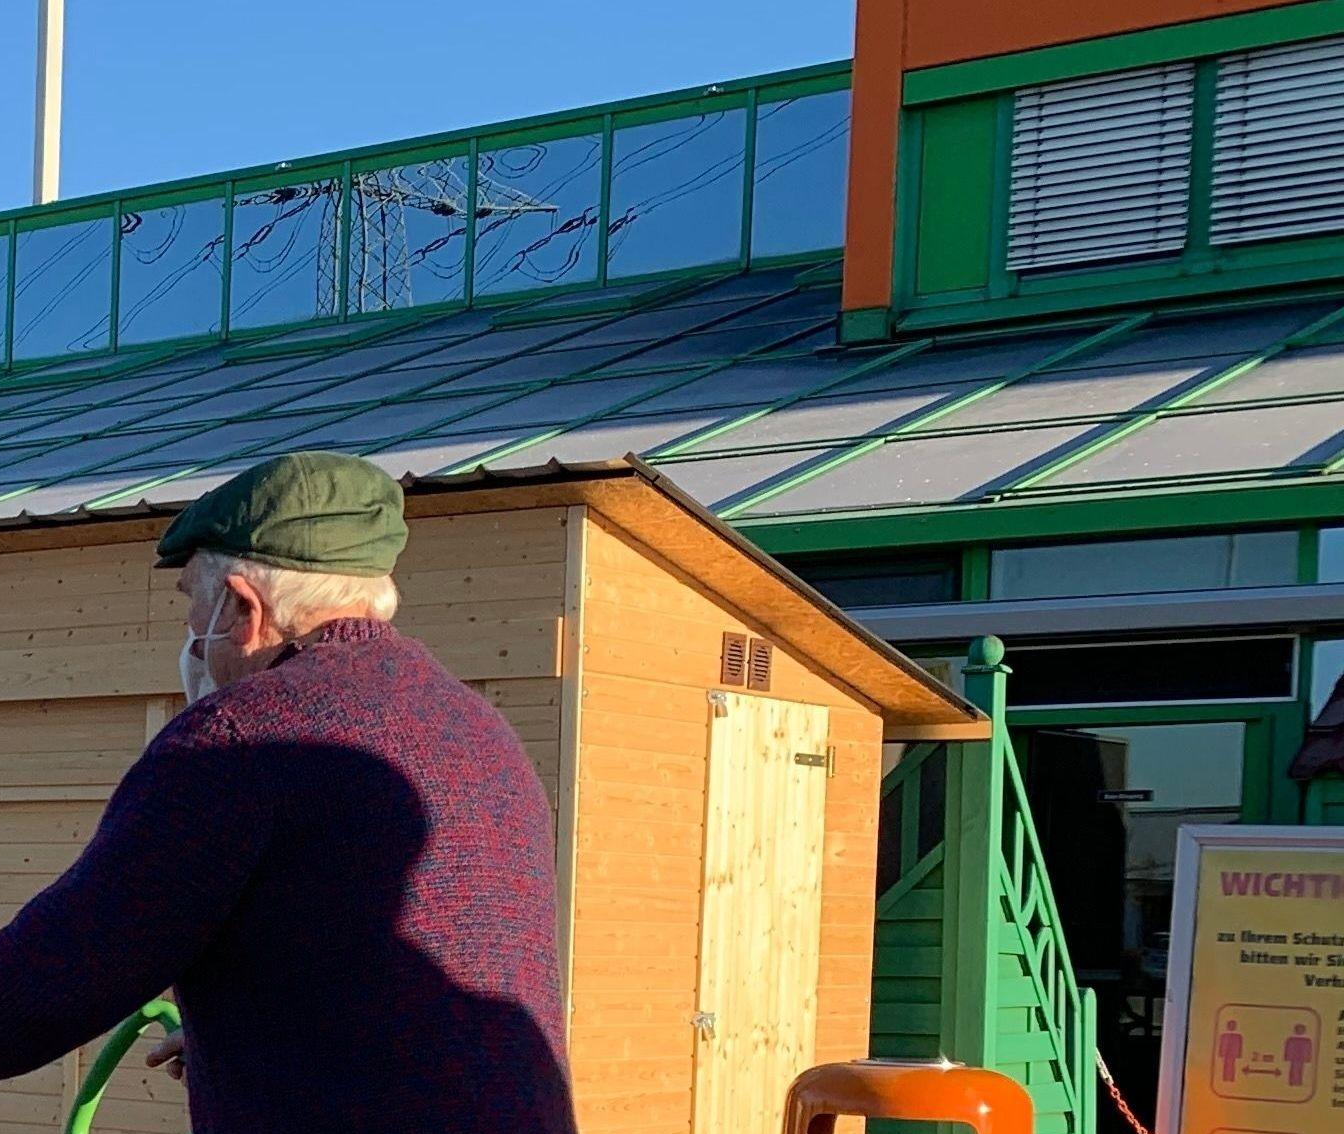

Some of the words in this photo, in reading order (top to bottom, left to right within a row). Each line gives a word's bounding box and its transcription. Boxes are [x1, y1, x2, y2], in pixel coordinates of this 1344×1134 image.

[1221, 871, 1344, 899] WICHTI
[1241, 930, 1287, 944] Ihrem
[1240, 949, 1288, 965] bitten
[1295, 952, 1320, 966] wir
